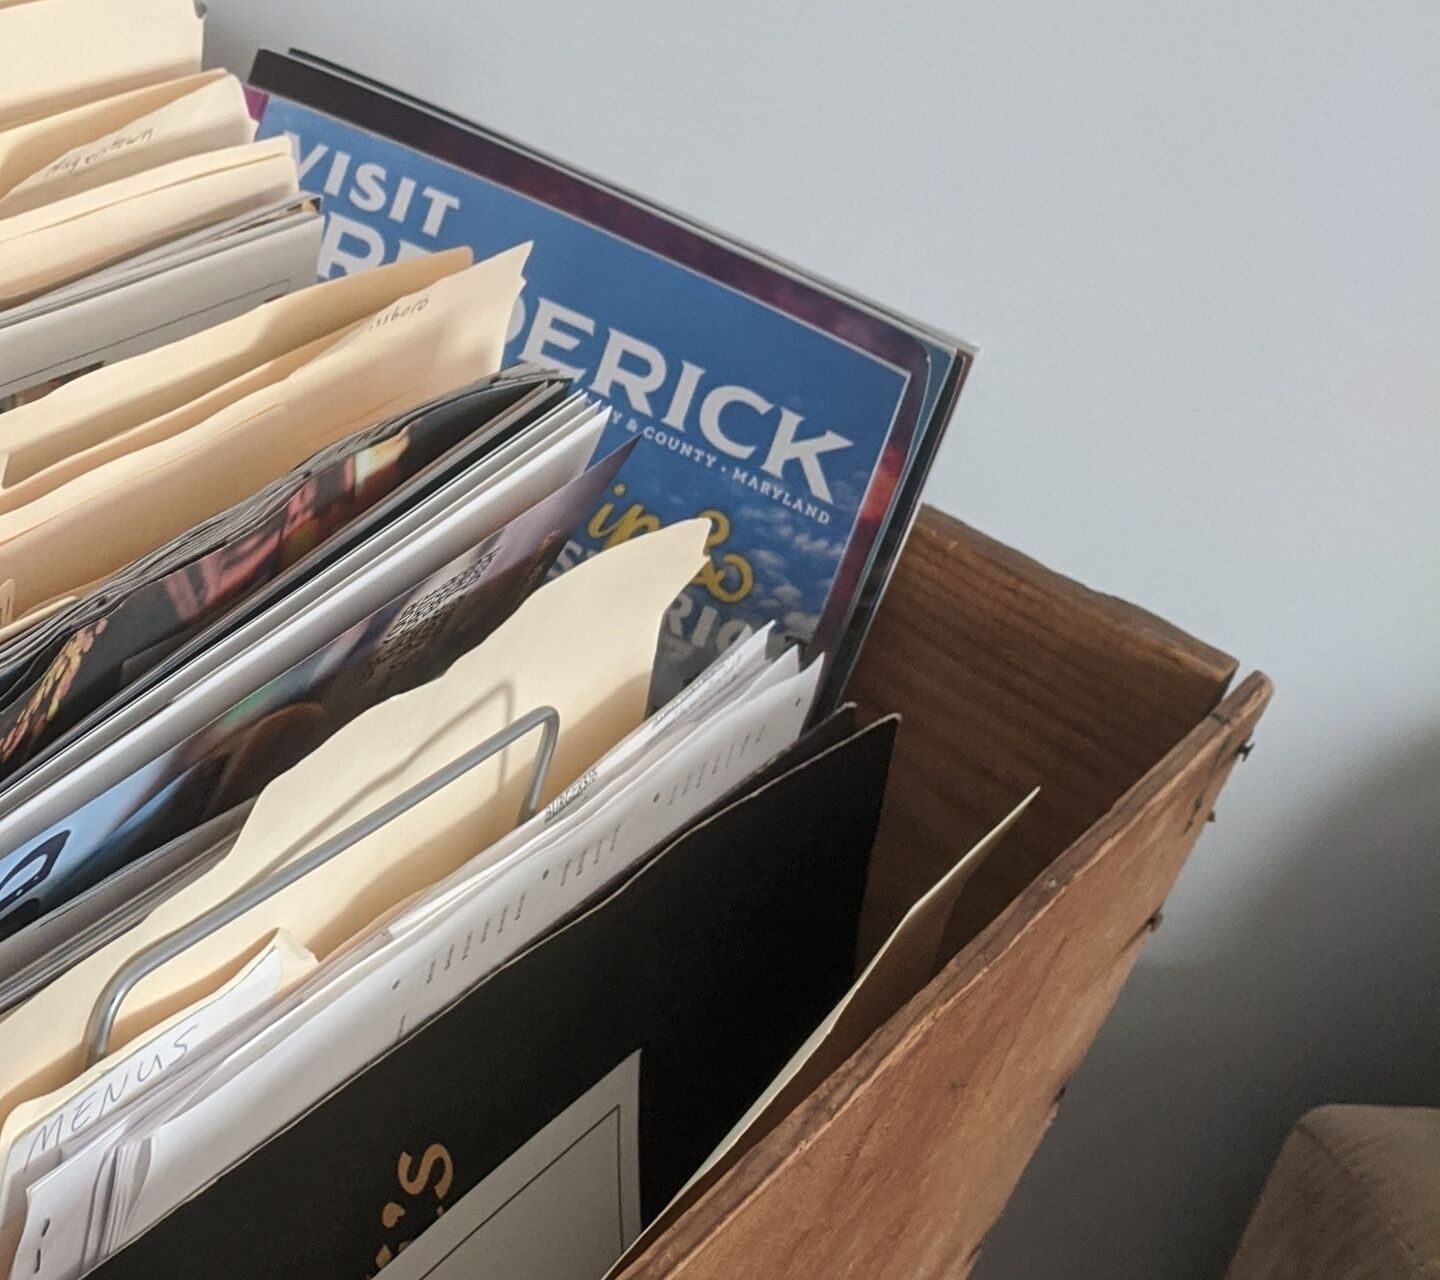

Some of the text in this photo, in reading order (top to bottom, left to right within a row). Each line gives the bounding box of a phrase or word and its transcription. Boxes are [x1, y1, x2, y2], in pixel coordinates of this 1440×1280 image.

[284, 131, 460, 238] VISIT
[642, 425, 717, 468] COUNTY
[732, 468, 832, 525] MARYLAND
[22, 1023, 200, 1173] MENUS
